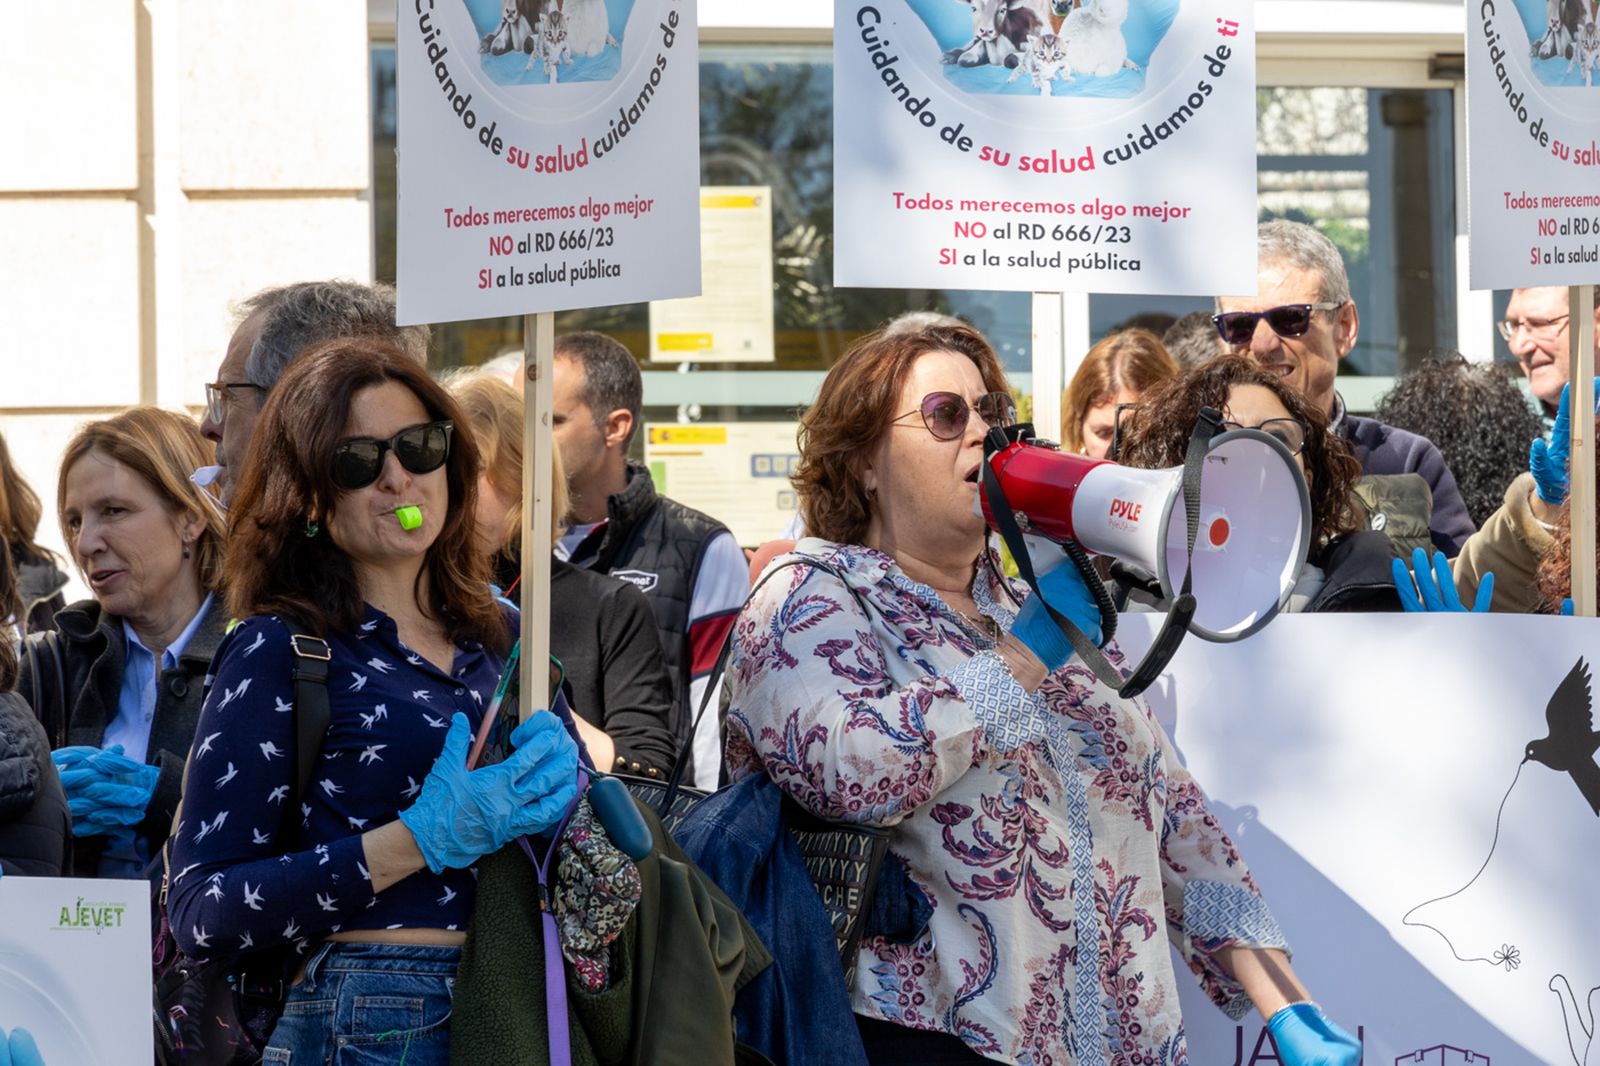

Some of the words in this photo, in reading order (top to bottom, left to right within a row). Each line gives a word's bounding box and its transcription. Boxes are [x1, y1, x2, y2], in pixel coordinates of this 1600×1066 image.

[1215, 17, 1240, 37] ti
[856, 5, 937, 128] Cuidando
[1202, 44, 1232, 78] de
[478, 121, 504, 156] de
[506, 146, 530, 170] su
[534, 137, 589, 174] salud
[592, 53, 667, 159] cuidamos
[659, 10, 680, 49] de
[1480, 0, 1528, 124] Cuidando
[1529, 118, 1549, 148] de
[1551, 140, 1570, 161] su
[939, 122, 974, 153] de
[1102, 79, 1213, 166] cuidamos
[978, 145, 1011, 167] su
[1017, 146, 1096, 174] salud
[444, 205, 490, 229] Todos
[493, 205, 576, 225] merecemos
[578, 196, 611, 223] algo
[613, 193, 654, 220] mejor
[892, 191, 954, 212] Todos
[959, 199, 1076, 215] merecemos
[1081, 197, 1127, 221] algo
[1132, 200, 1192, 223] mejor
[1503, 190, 1539, 210] Todos
[489, 235, 514, 257] NO
[517, 232, 531, 255] al
[535, 231, 556, 253] RD
[558, 226, 614, 251] 666/23
[954, 221, 987, 239] NO
[992, 221, 1012, 240] al
[1017, 222, 1046, 241] RD
[1051, 224, 1132, 245] 666/23
[1538, 218, 1558, 237] NO
[1559, 217, 1571, 236] al
[1573, 217, 1590, 236] RD
[938, 247, 957, 266] SI
[962, 254, 976, 266] a
[982, 248, 1001, 267] la
[1007, 249, 1062, 269] salud
[1067, 251, 1141, 274] pública
[1530, 247, 1541, 265] SI
[1543, 252, 1552, 265] a
[1554, 245, 1565, 264] la
[1567, 244, 1599, 264] salud
[478, 268, 492, 290] SI
[495, 274, 506, 288] a
[510, 265, 524, 287] la
[527, 261, 567, 286] salud
[570, 258, 621, 287] pública
[59, 903, 125, 928] AJEVET
